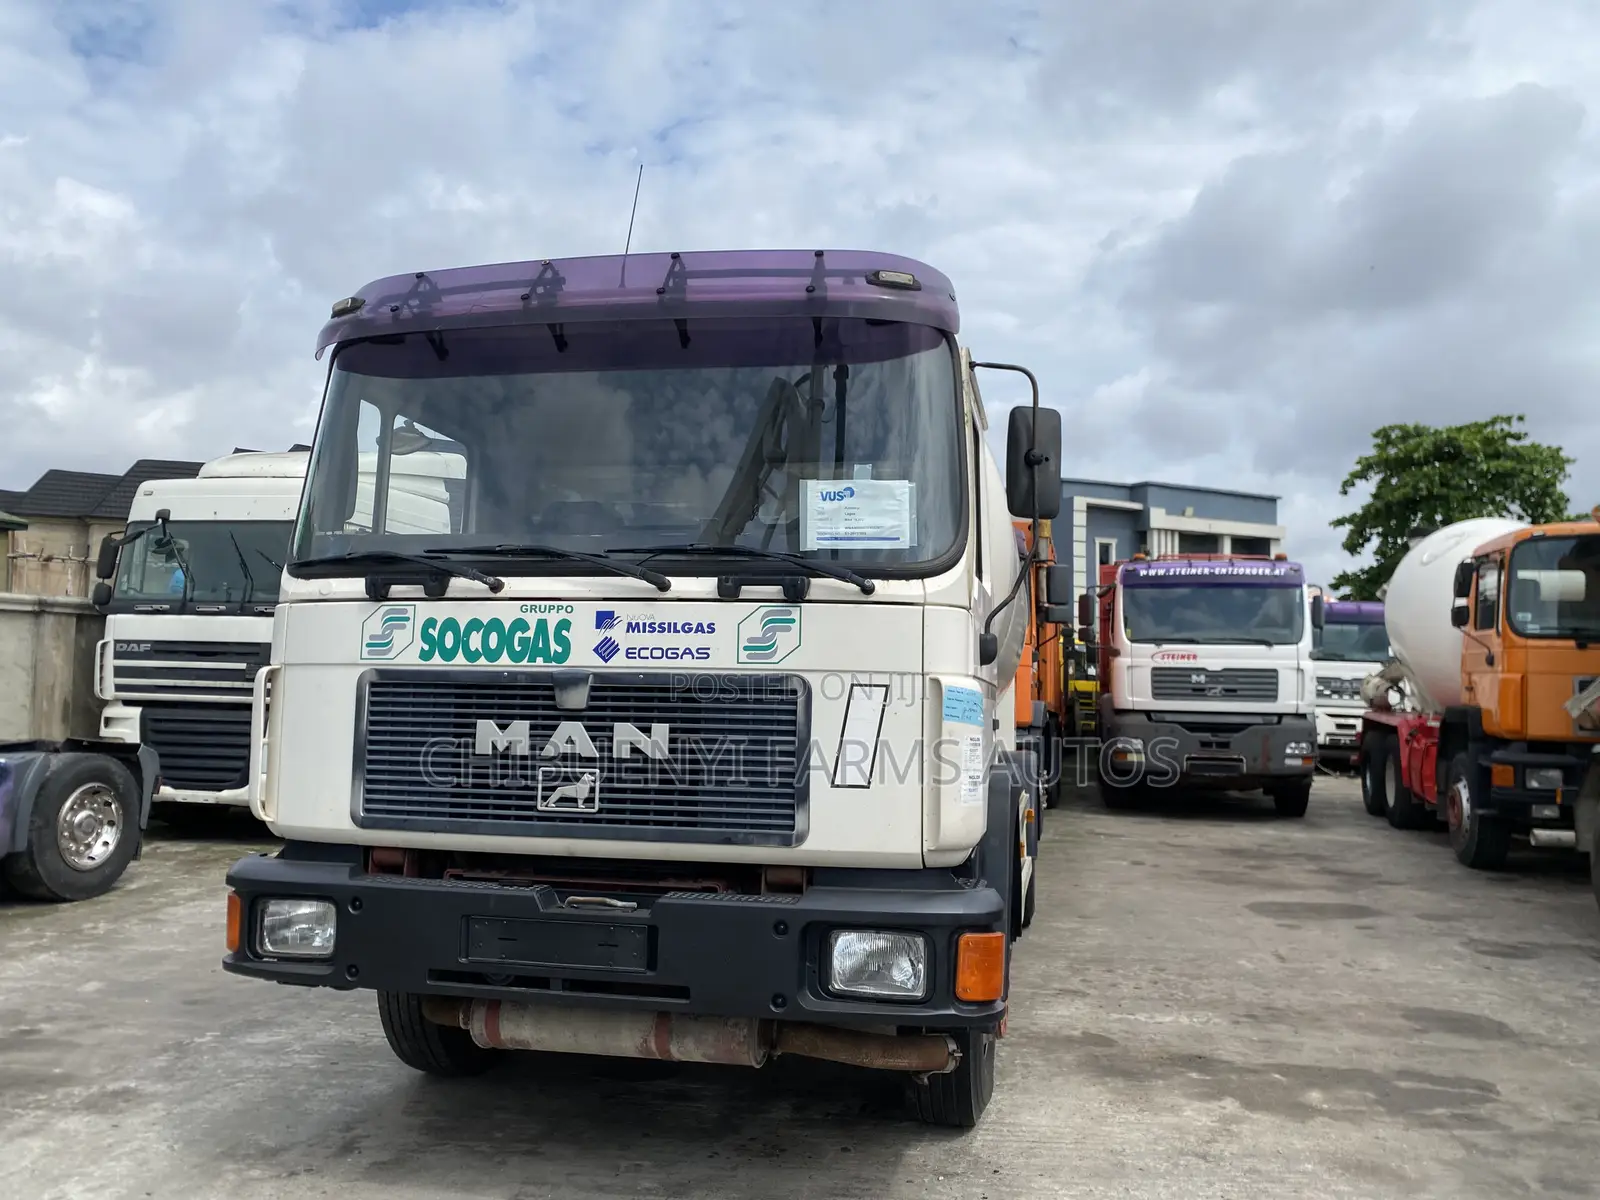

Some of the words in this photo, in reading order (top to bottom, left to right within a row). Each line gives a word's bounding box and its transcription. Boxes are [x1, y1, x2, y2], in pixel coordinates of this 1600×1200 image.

[820, 490, 845, 502] VUS
[520, 604, 574, 614] GRUPPO
[625, 621, 717, 635] MISSILGAS
[418, 616, 573, 664] SOCOGAS
[115, 642, 151, 652] DAF
[625, 647, 711, 660] ECOGAS
[1160, 653, 1198, 661] STEINER
[475, 719, 670, 759] MAN
